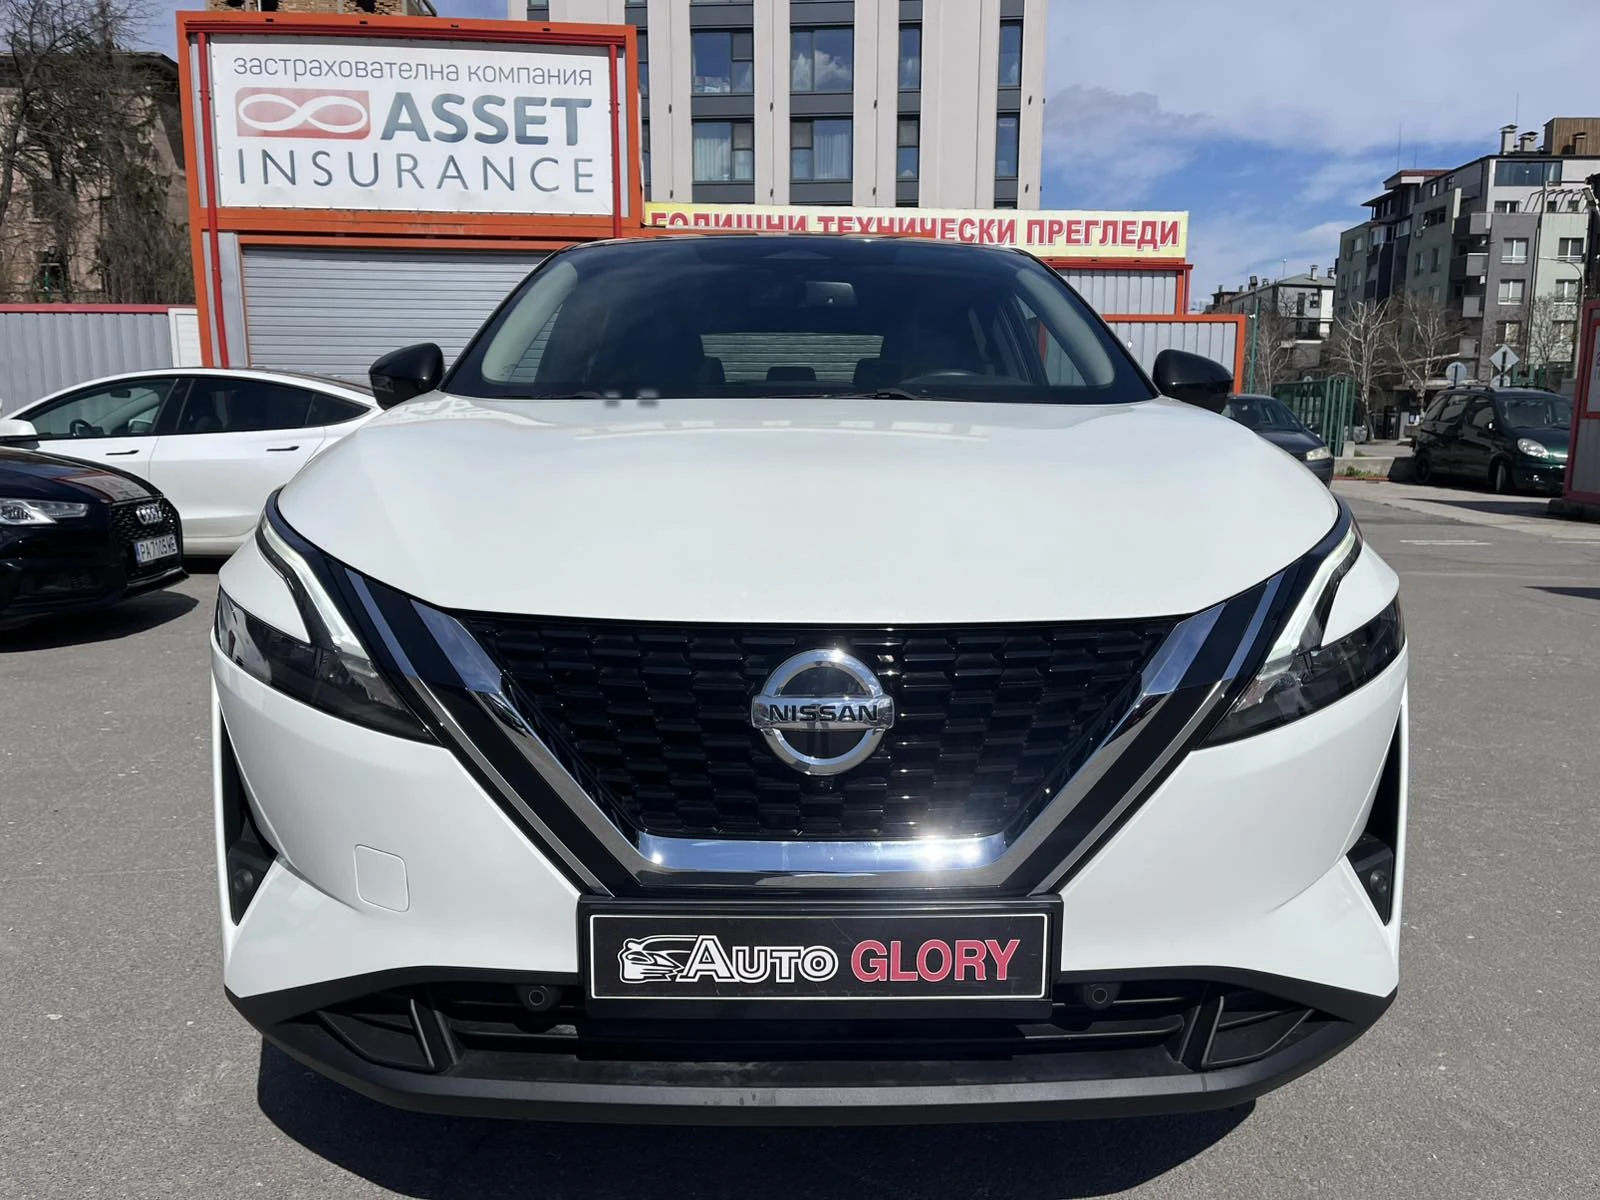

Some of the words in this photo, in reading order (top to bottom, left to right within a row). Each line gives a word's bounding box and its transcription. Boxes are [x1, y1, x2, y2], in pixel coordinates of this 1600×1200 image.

[233, 57, 459, 82] застрахователна
[468, 64, 592, 86] компания
[380, 91, 593, 146] ASSET
[238, 148, 594, 193] INSURANCE
[1026, 219, 1180, 250] ПРЕГЛЕДИ
[769, 704, 878, 721] NISSAN
[675, 935, 839, 983] AUTO
[851, 939, 1021, 982] GLORY
